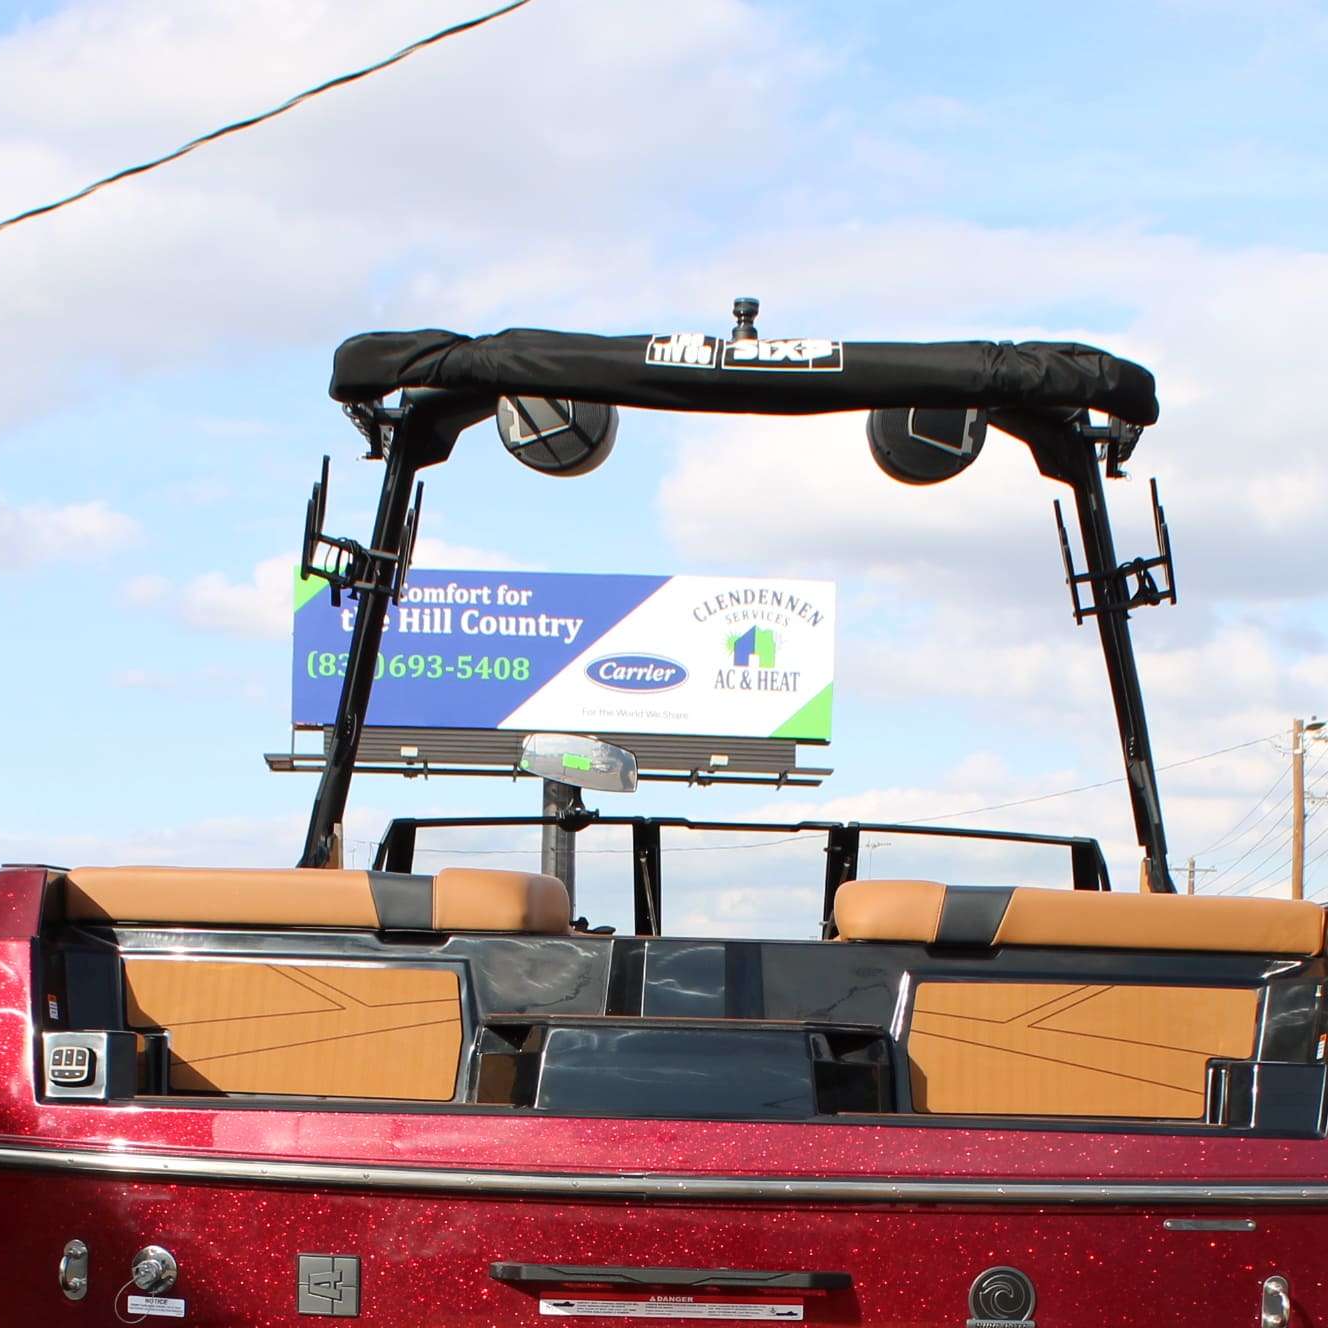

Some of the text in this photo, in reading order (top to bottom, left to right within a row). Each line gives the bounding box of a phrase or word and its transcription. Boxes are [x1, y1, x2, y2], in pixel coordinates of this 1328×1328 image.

[496, 584, 533, 607] for
[692, 587, 825, 628] CLENDENNEN
[725, 608, 790, 628] SERVICES
[398, 606, 453, 635] Hill
[460, 608, 584, 644] Country
[598, 661, 676, 683] Carrier
[714, 669, 801, 692] AC & HEAT
[657, 1295, 694, 1303] DANGER
